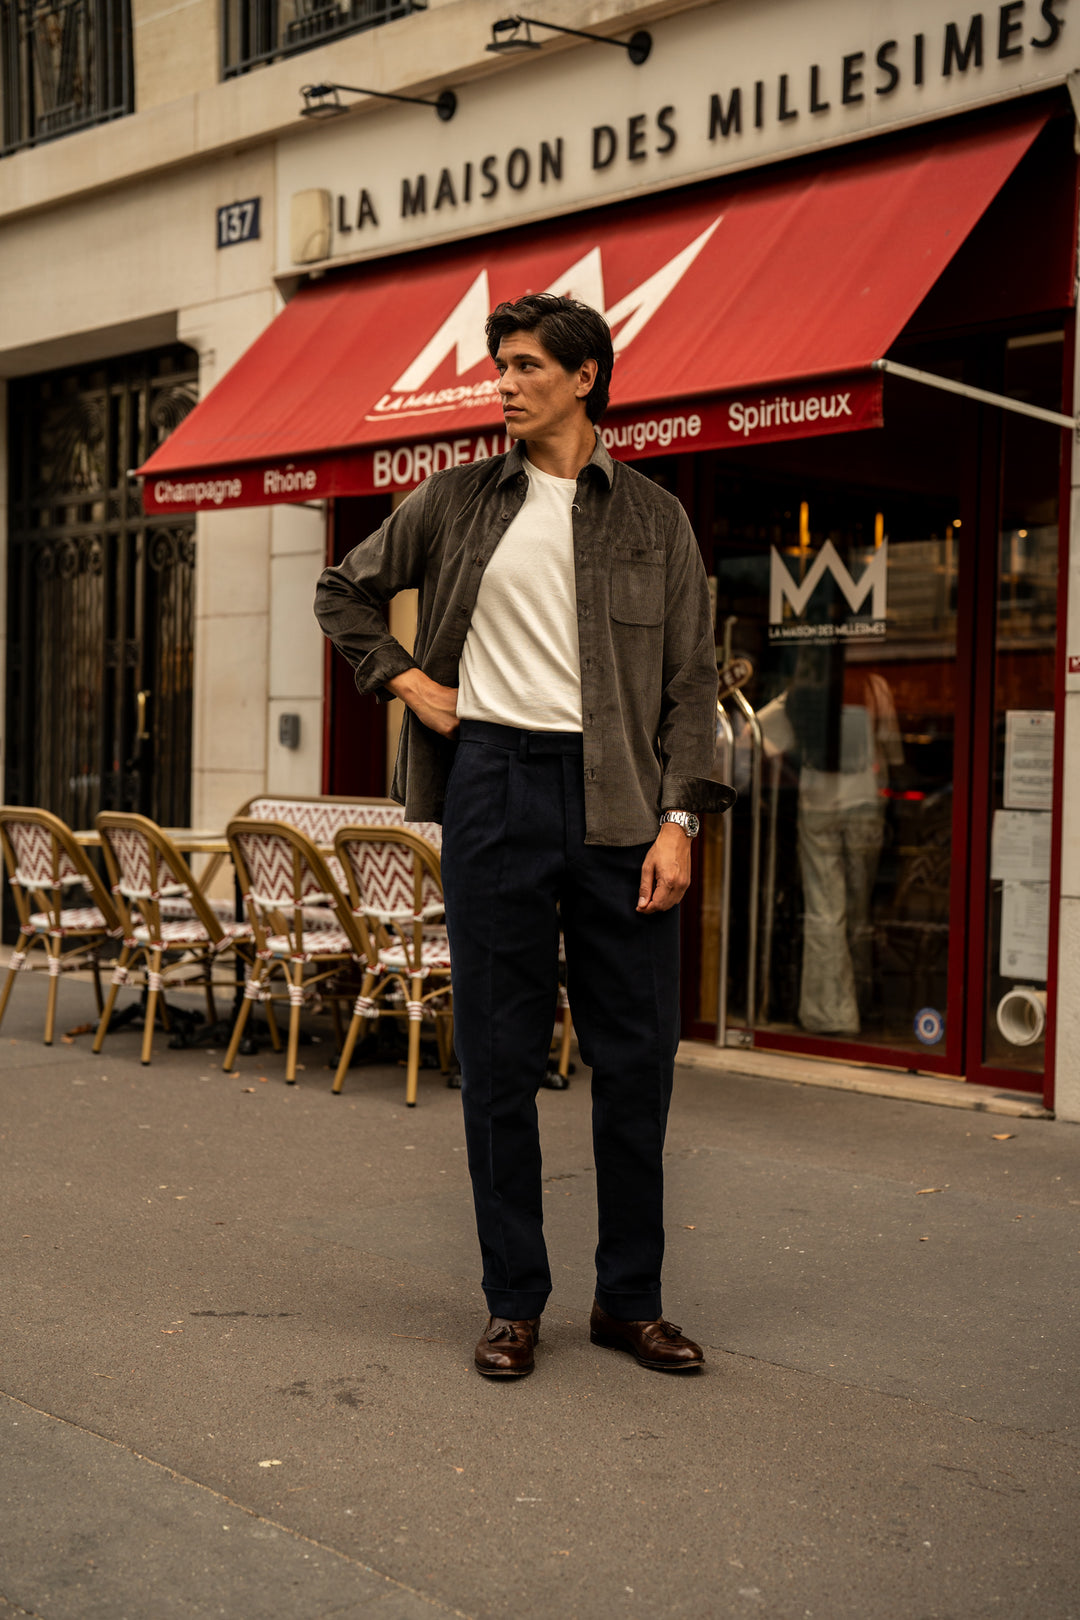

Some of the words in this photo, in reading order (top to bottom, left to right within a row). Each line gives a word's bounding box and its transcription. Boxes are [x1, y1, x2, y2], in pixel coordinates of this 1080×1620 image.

[338, 190, 378, 233] LA
[400, 137, 563, 219] MAISON
[592, 105, 677, 171] DES
[708, 0, 1066, 141] MILLESIMES
[219, 202, 256, 244] 137
[154, 478, 242, 505] Champagne
[263, 464, 317, 495] Rhône
[373, 433, 518, 488] BORDEAU
[727, 392, 853, 436] Spiritueux
